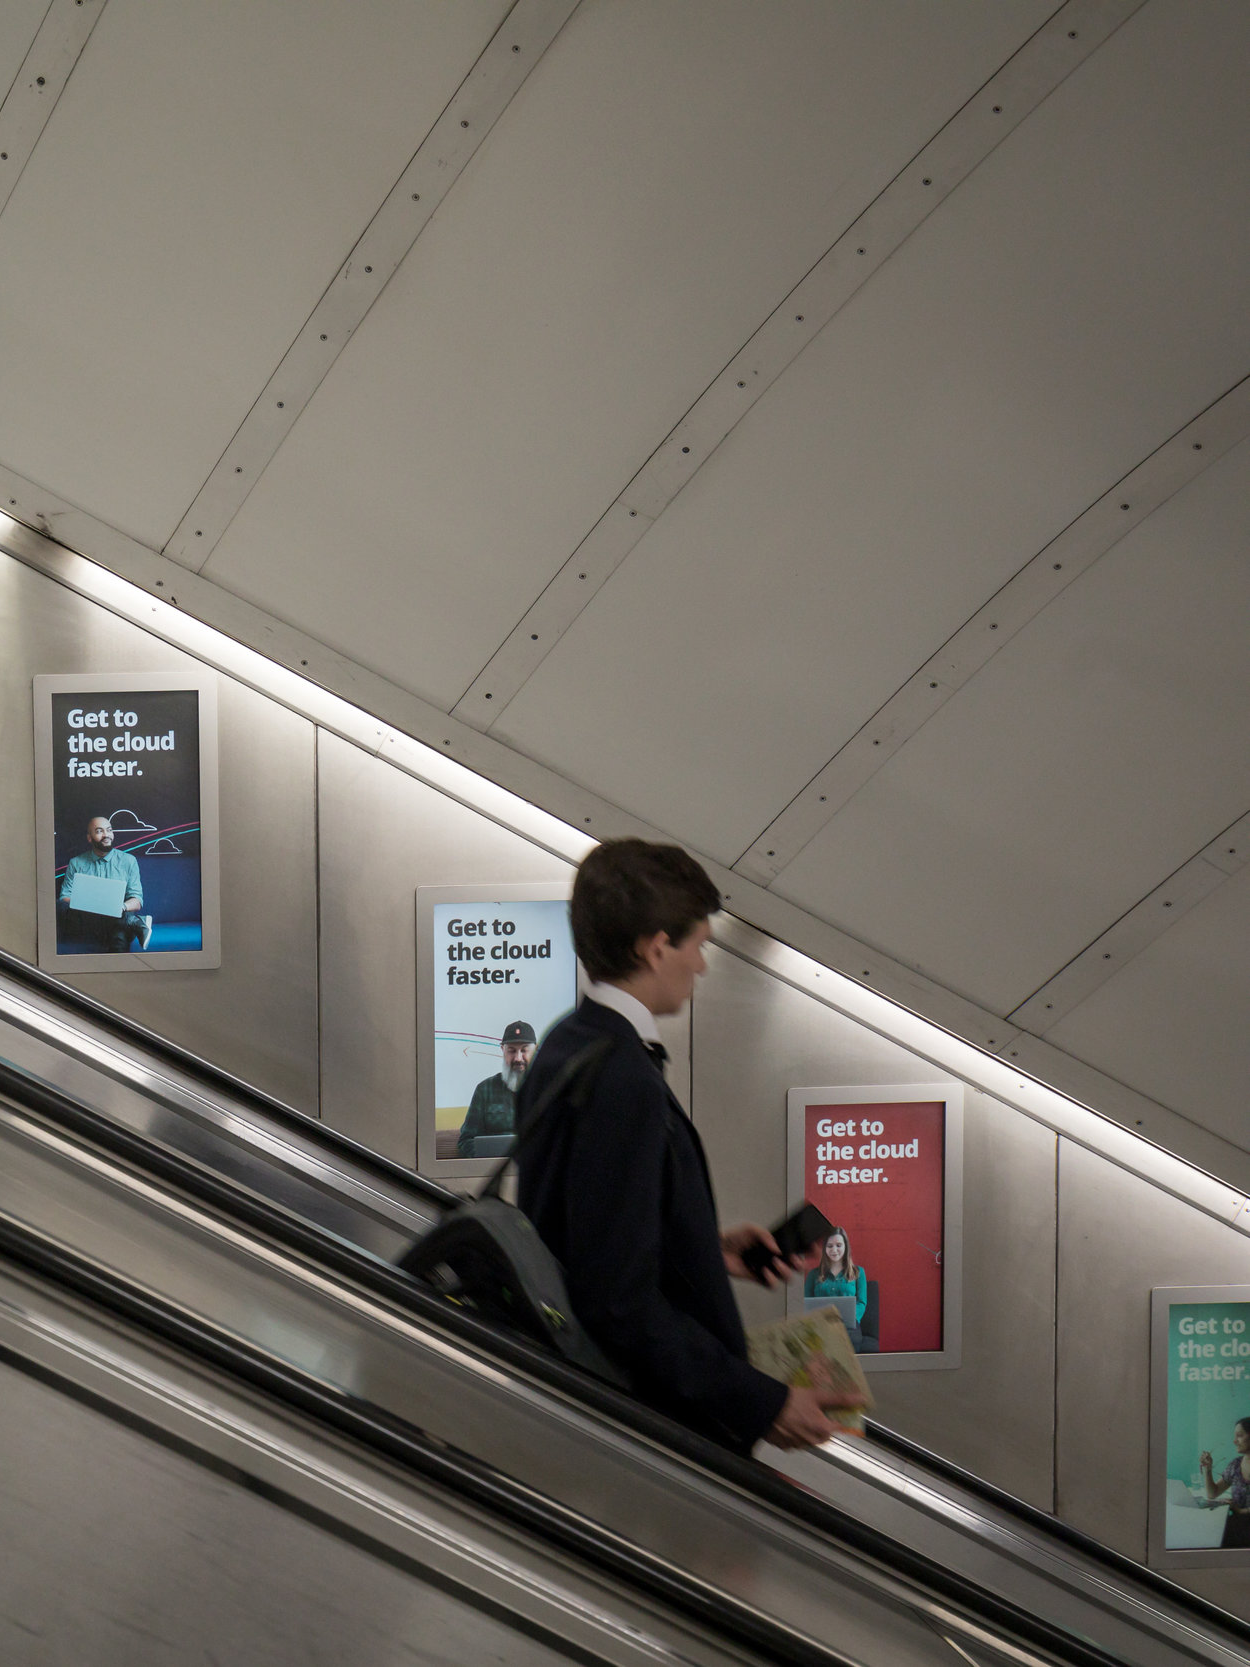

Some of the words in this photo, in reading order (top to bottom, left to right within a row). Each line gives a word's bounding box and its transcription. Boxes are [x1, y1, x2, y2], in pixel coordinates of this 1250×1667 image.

[67, 708, 109, 729] Get
[112, 709, 139, 728] to
[67, 733, 108, 754] the
[111, 731, 175, 753] cloud
[67, 757, 143, 778] faster.
[447, 918, 488, 938] Get
[491, 918, 516, 937] to
[446, 941, 486, 962] the
[490, 940, 552, 961] cloud
[446, 965, 521, 986] faster.
[816, 1118, 857, 1138] Get
[859, 1118, 885, 1137] to
[815, 1142, 855, 1162] the
[858, 1139, 919, 1160] cloud
[816, 1165, 889, 1185] faster.
[1178, 1317, 1218, 1336] Get
[1222, 1317, 1246, 1335] to
[1177, 1339, 1216, 1359] the
[1178, 1362, 1250, 1382] faster.
